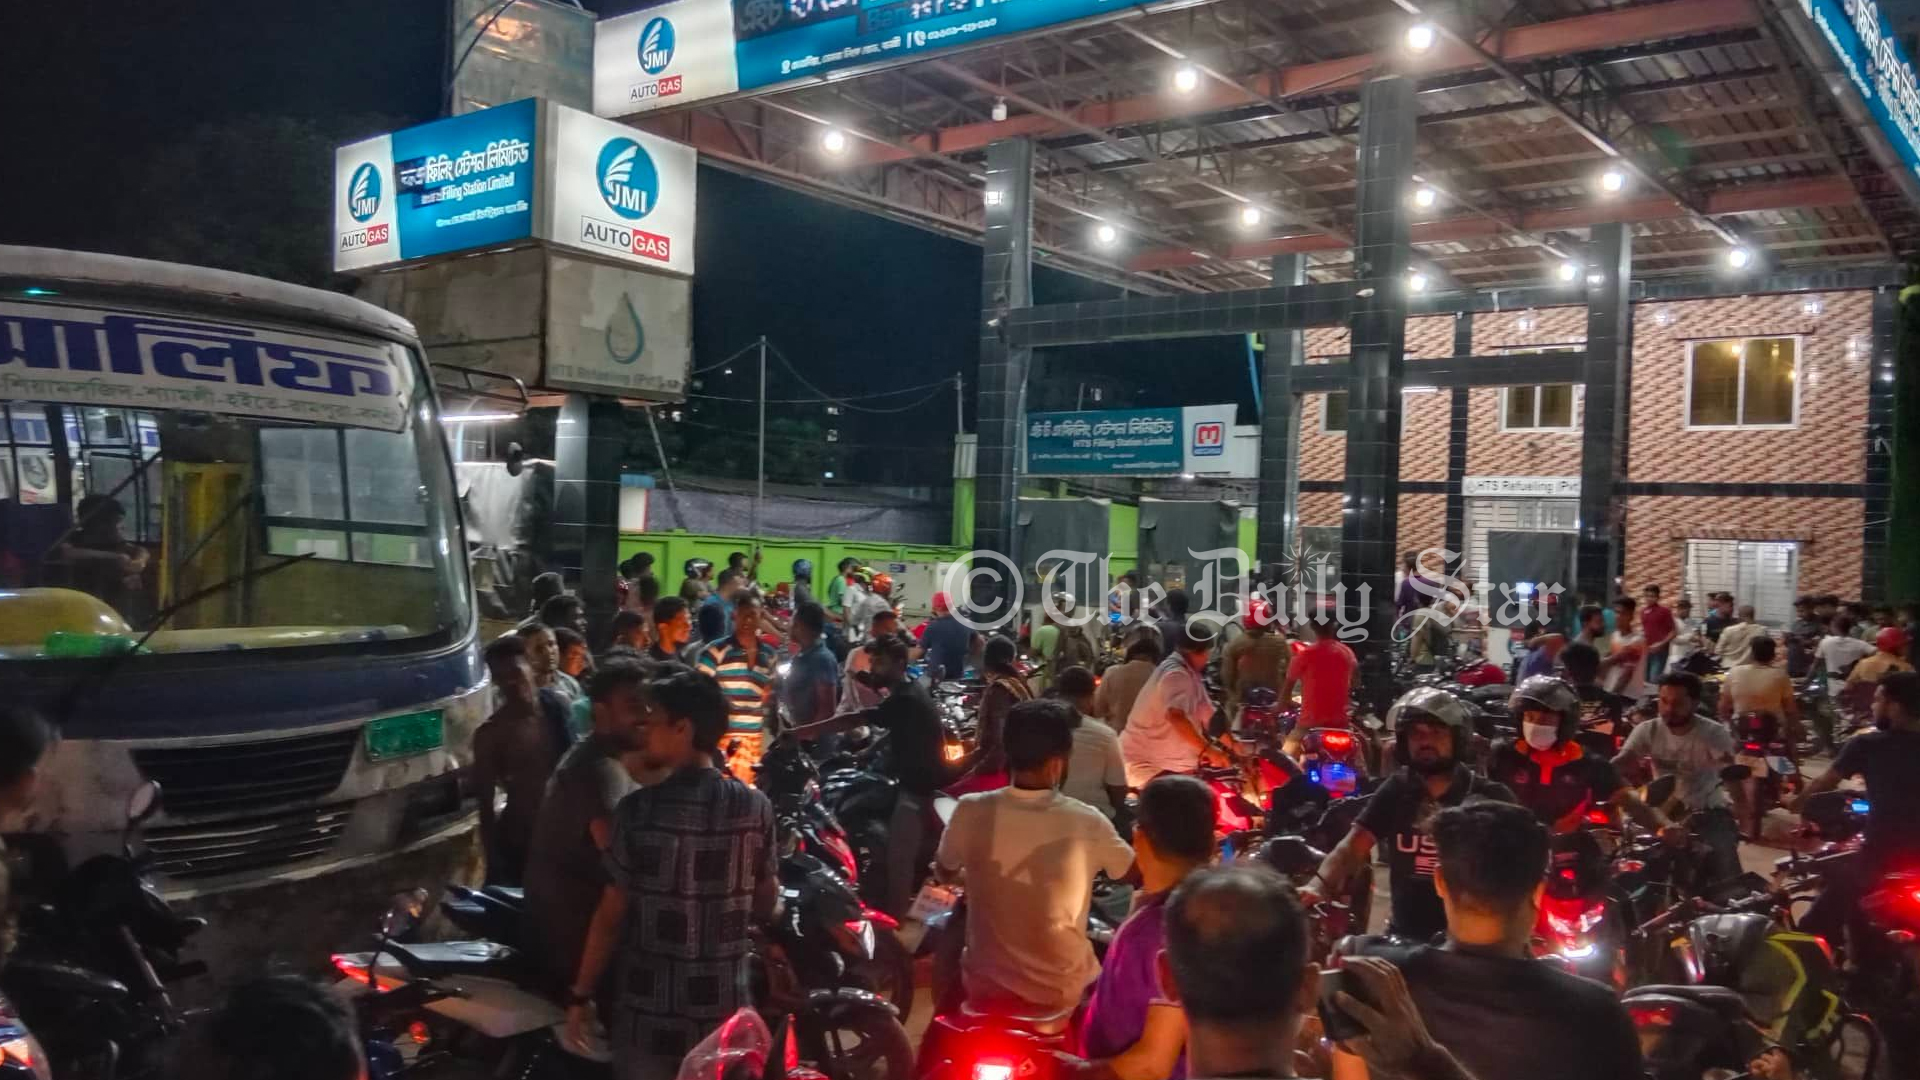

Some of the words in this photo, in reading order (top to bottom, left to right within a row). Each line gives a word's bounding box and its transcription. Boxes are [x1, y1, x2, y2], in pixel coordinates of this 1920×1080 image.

[644, 49, 669, 70] JMI
[354, 196, 378, 218] JMI
[608, 182, 649, 214] JMI
